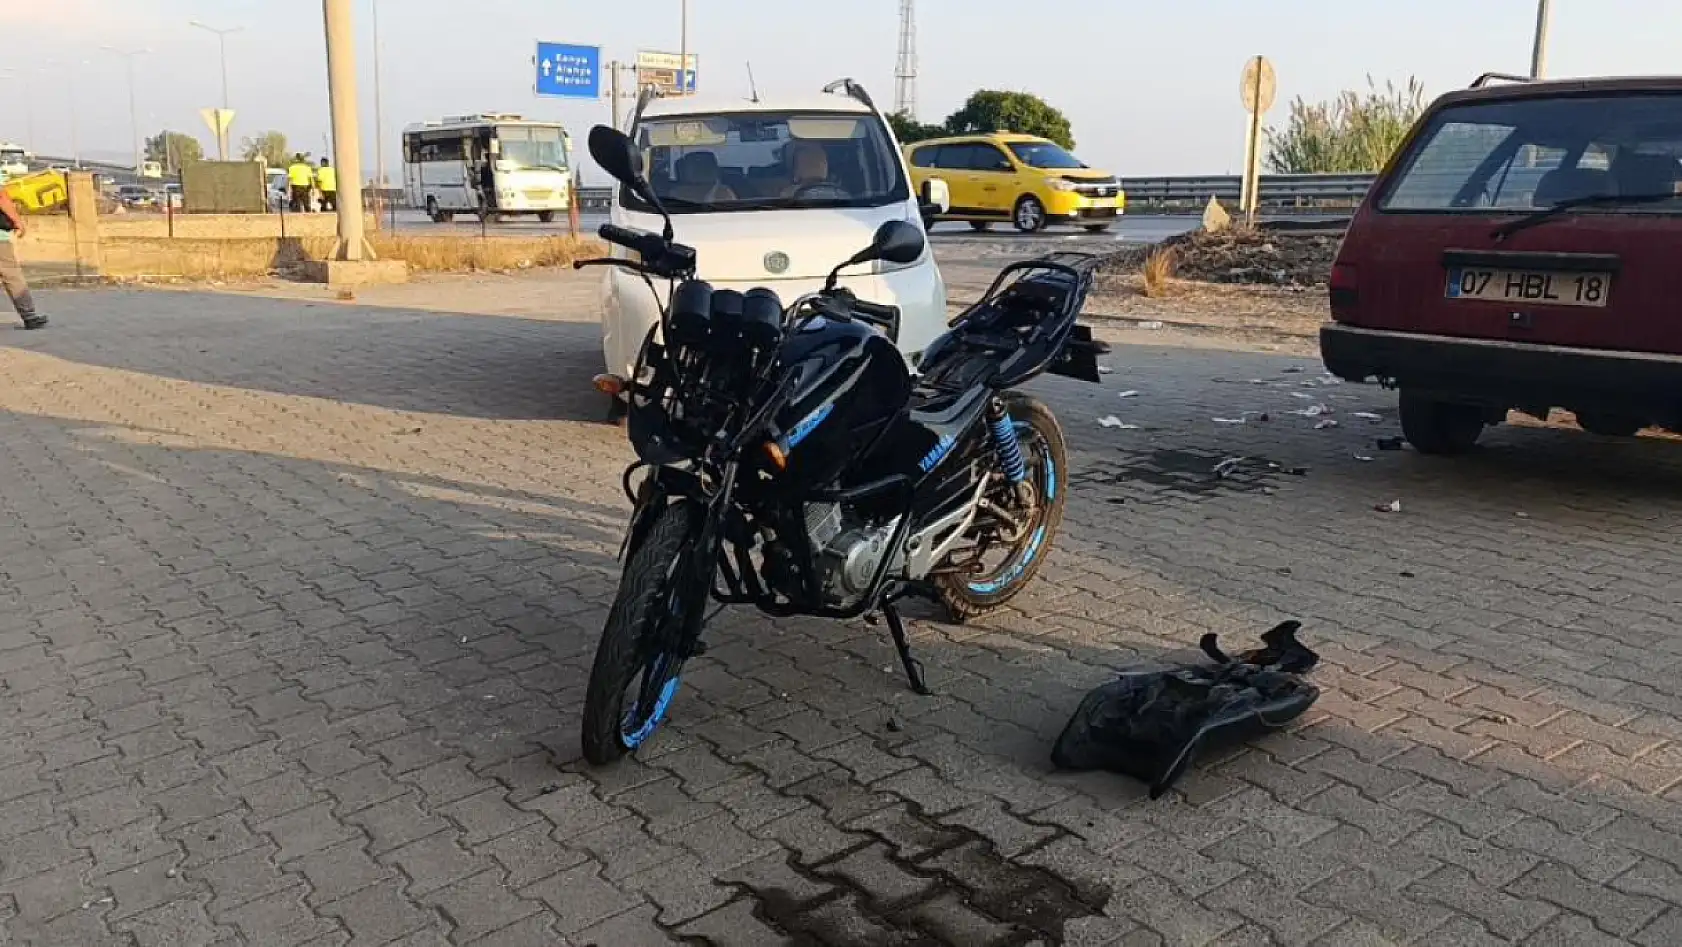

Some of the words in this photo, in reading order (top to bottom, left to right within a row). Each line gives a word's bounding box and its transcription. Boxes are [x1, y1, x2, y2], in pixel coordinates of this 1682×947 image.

[1460, 271, 1491, 295] 07
[1505, 273, 1558, 299] HBL
[1574, 276, 1601, 302] 18
